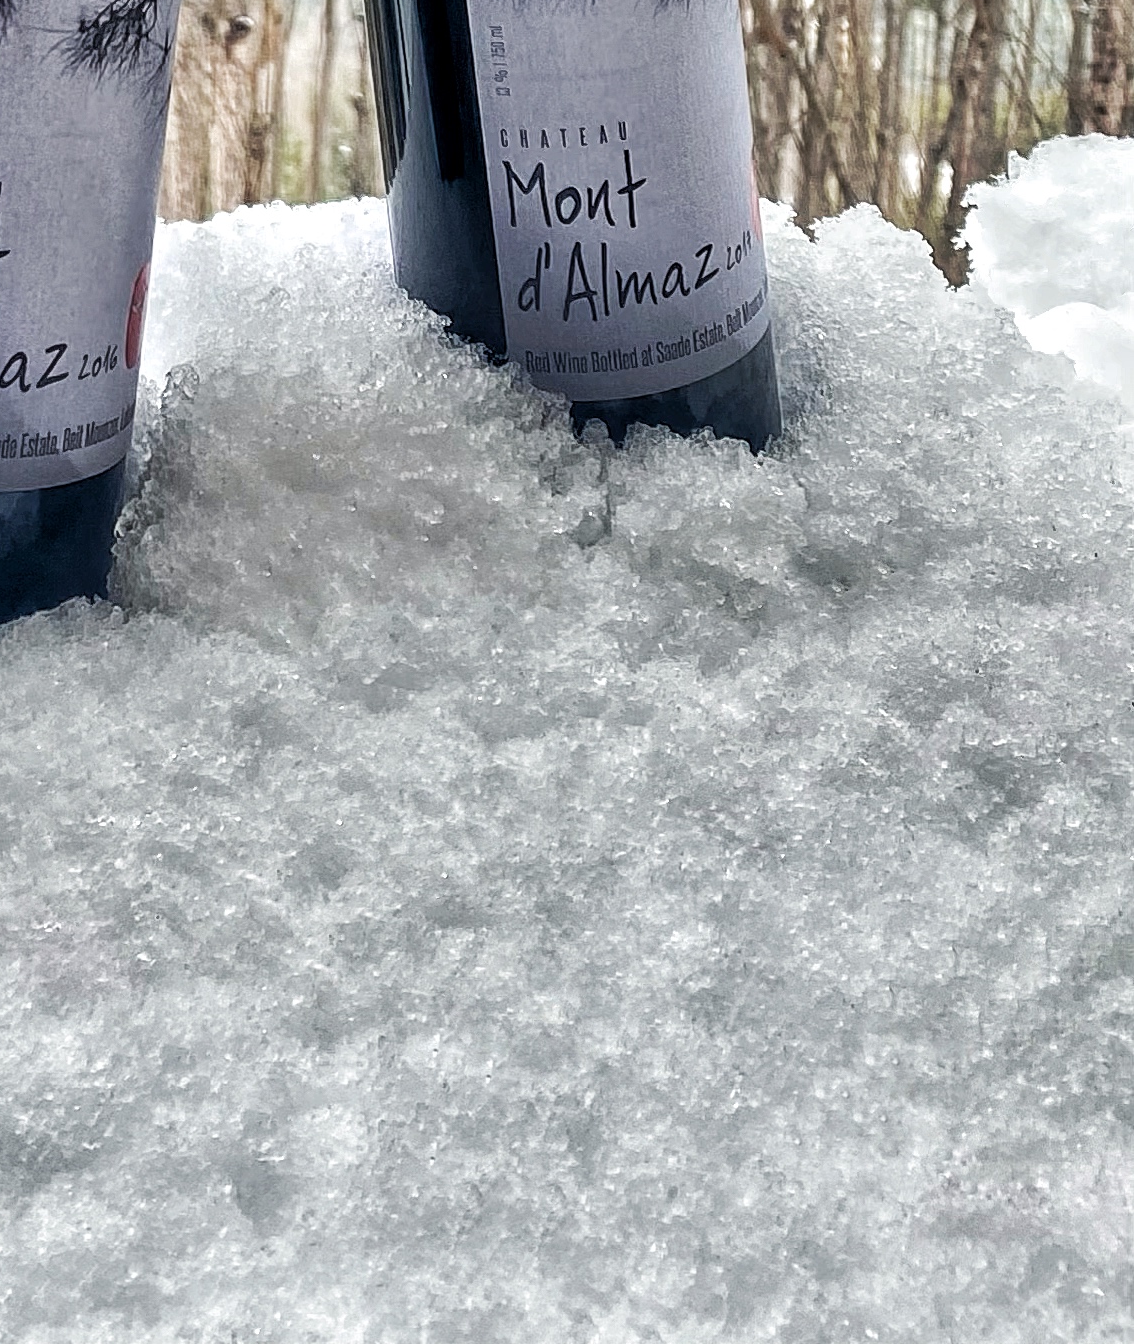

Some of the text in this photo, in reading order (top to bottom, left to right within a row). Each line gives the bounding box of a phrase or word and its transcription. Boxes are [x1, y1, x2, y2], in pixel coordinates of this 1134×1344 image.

[488, 25, 504, 39] ml
[490, 41, 506, 58] 750
[500, 121, 628, 149] CHATEAU
[501, 148, 648, 229] Mont
[517, 241, 720, 322] d'Almaz
[77, 344, 119, 381] 2016
[525, 349, 551, 374] Red
[552, 351, 588, 374] Wine
[590, 346, 639, 373] Bottled
[641, 343, 654, 367] at
[655, 335, 692, 364] Saade
